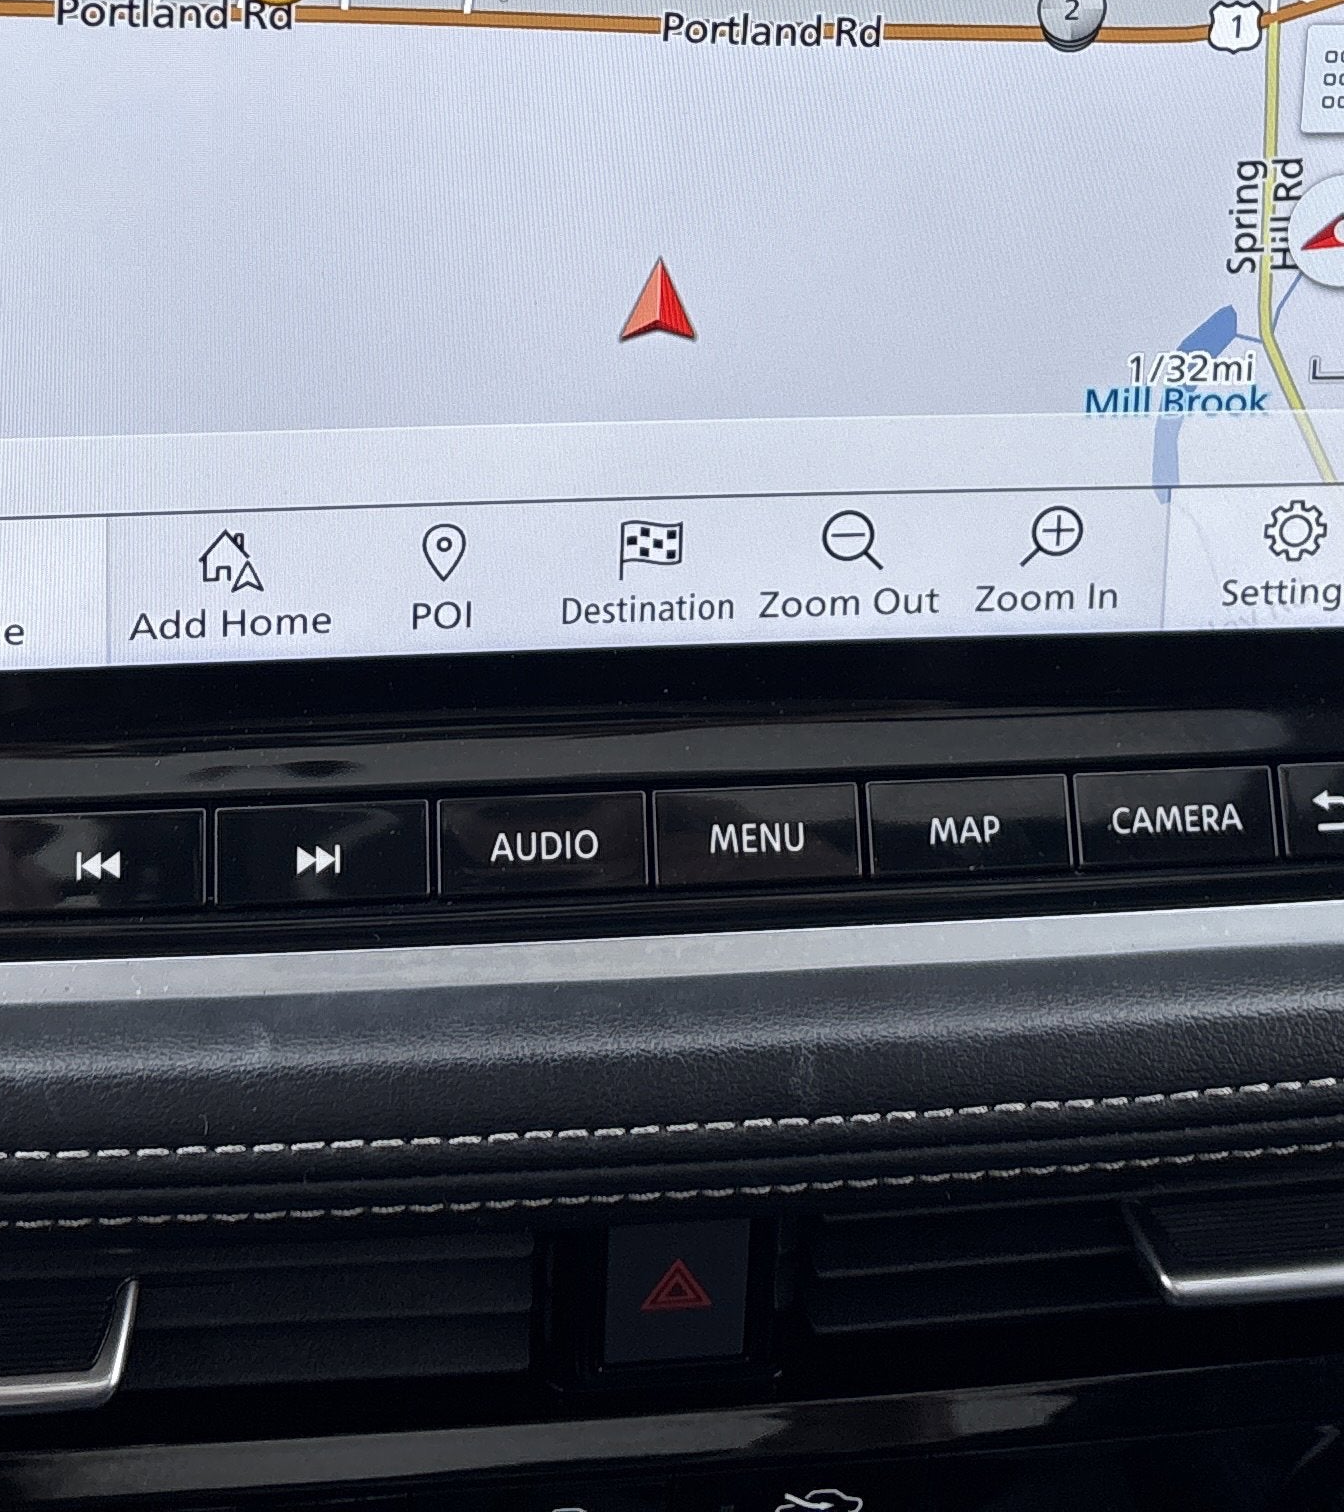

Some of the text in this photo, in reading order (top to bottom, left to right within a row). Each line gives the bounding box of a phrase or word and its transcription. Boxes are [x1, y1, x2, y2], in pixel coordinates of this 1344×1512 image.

[661, 12, 883, 48] Portland Rd
[1231, 14, 1242, 39] 1
[1226, 160, 1268, 274] Spring
[1269, 158, 1304, 270] Hill Rd
[1130, 353, 1254, 383] 1/32mi
[1085, 384, 1268, 413] Mill Brook
[561, 593, 735, 625] Destination
[759, 587, 940, 619] Zoom Out
[975, 583, 1119, 613] Zoom In
[129, 609, 333, 641] Add Home
[412, 600, 473, 630] POI
[929, 815, 1001, 846] MAP
[1111, 802, 1244, 836] CAMERA
[490, 828, 600, 863] AUDIO
[709, 821, 806, 855] MENU
